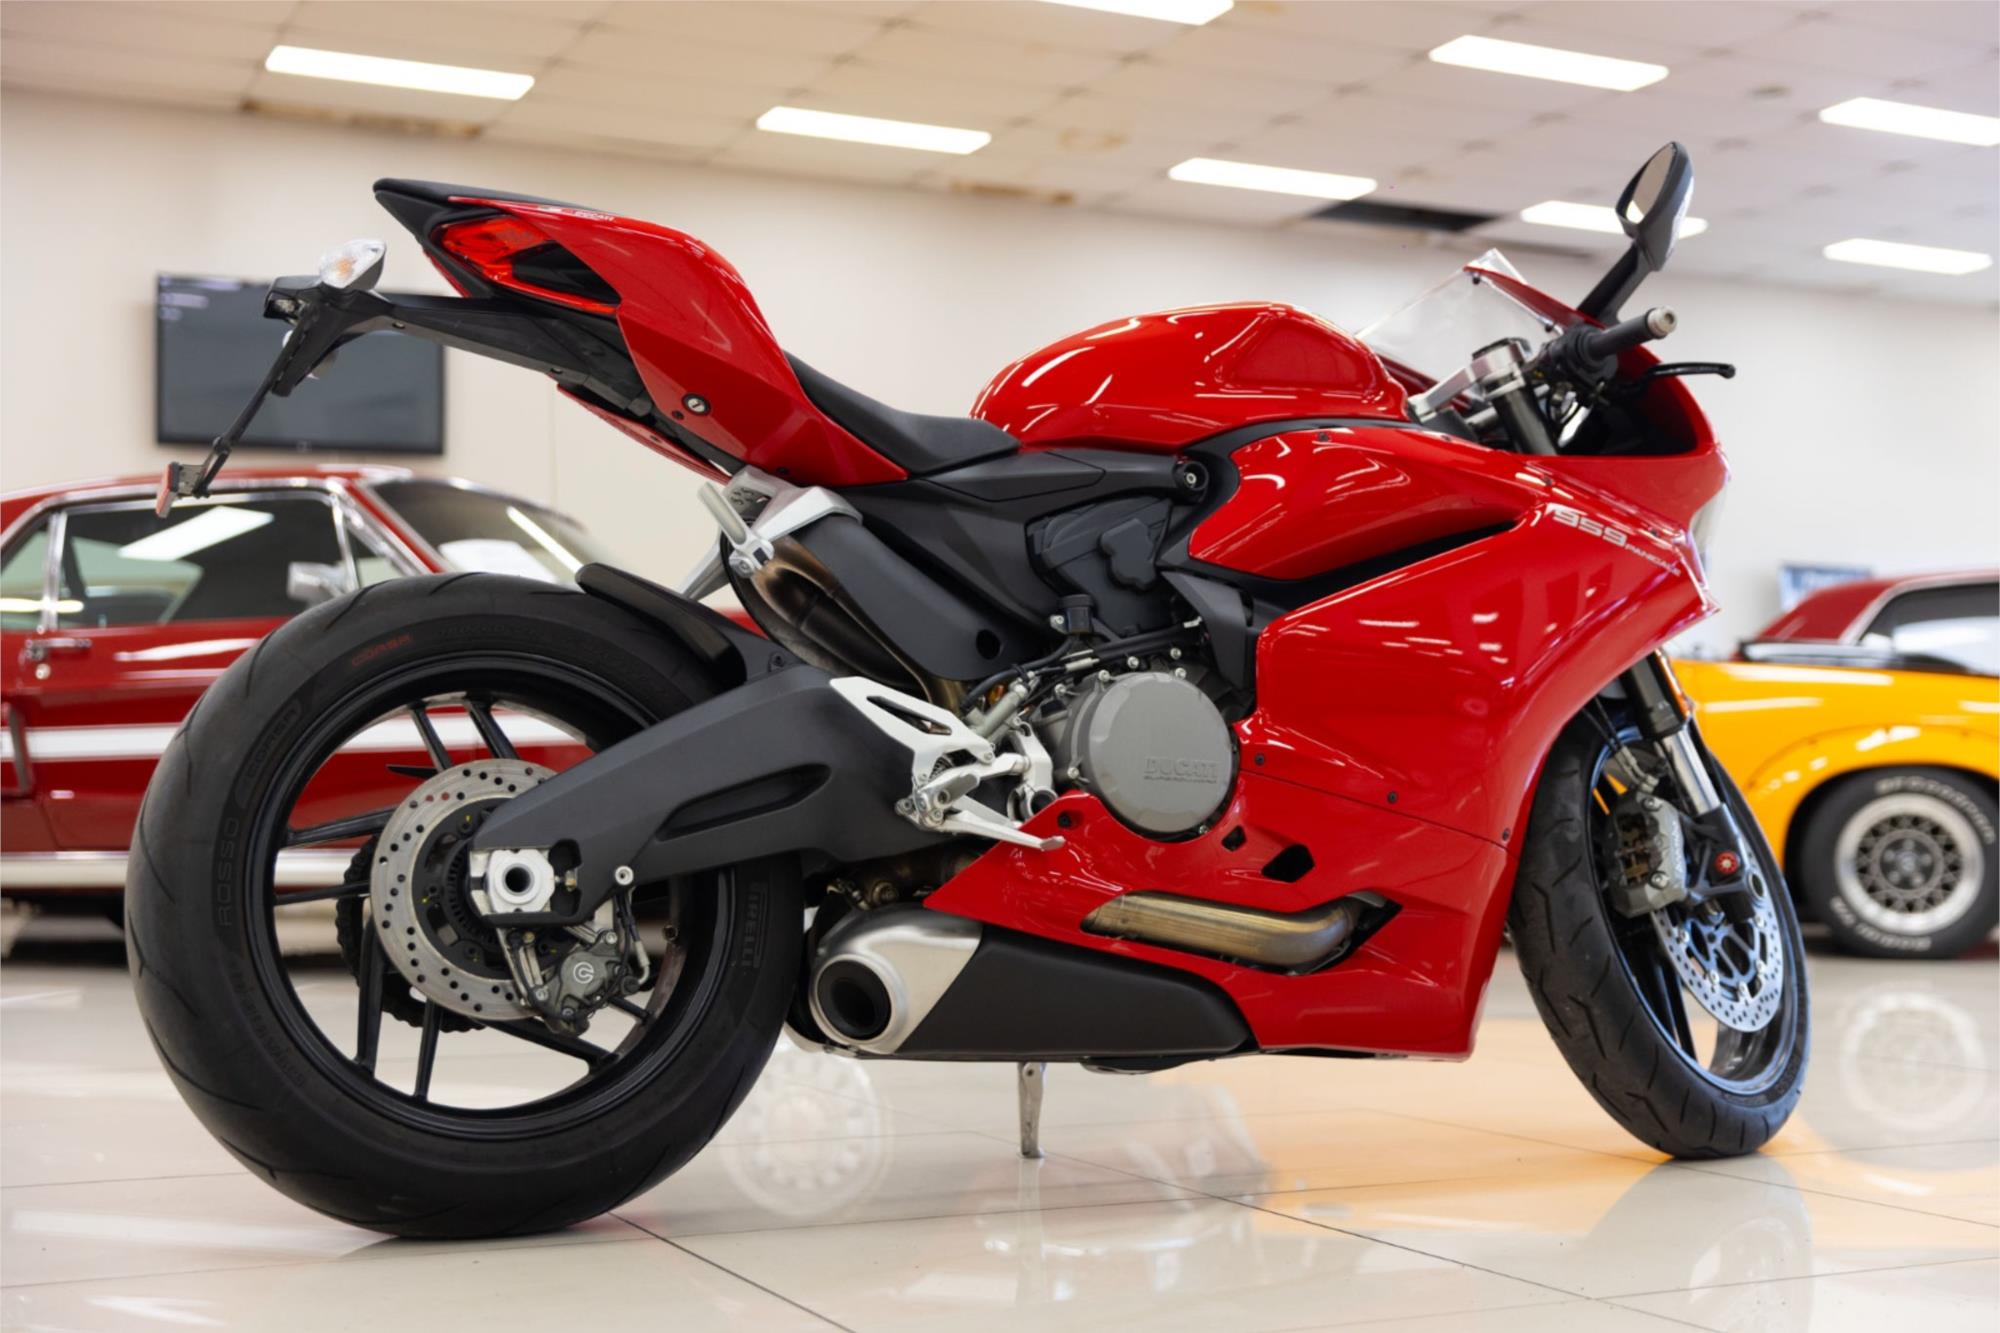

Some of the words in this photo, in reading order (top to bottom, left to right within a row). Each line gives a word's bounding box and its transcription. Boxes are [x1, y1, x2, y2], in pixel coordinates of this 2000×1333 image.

[1552, 509, 1628, 548] 959
[1144, 757, 1217, 779] DUCATI
[216, 816, 240, 927] ROSSO
[741, 881, 768, 969] PIRELLI
